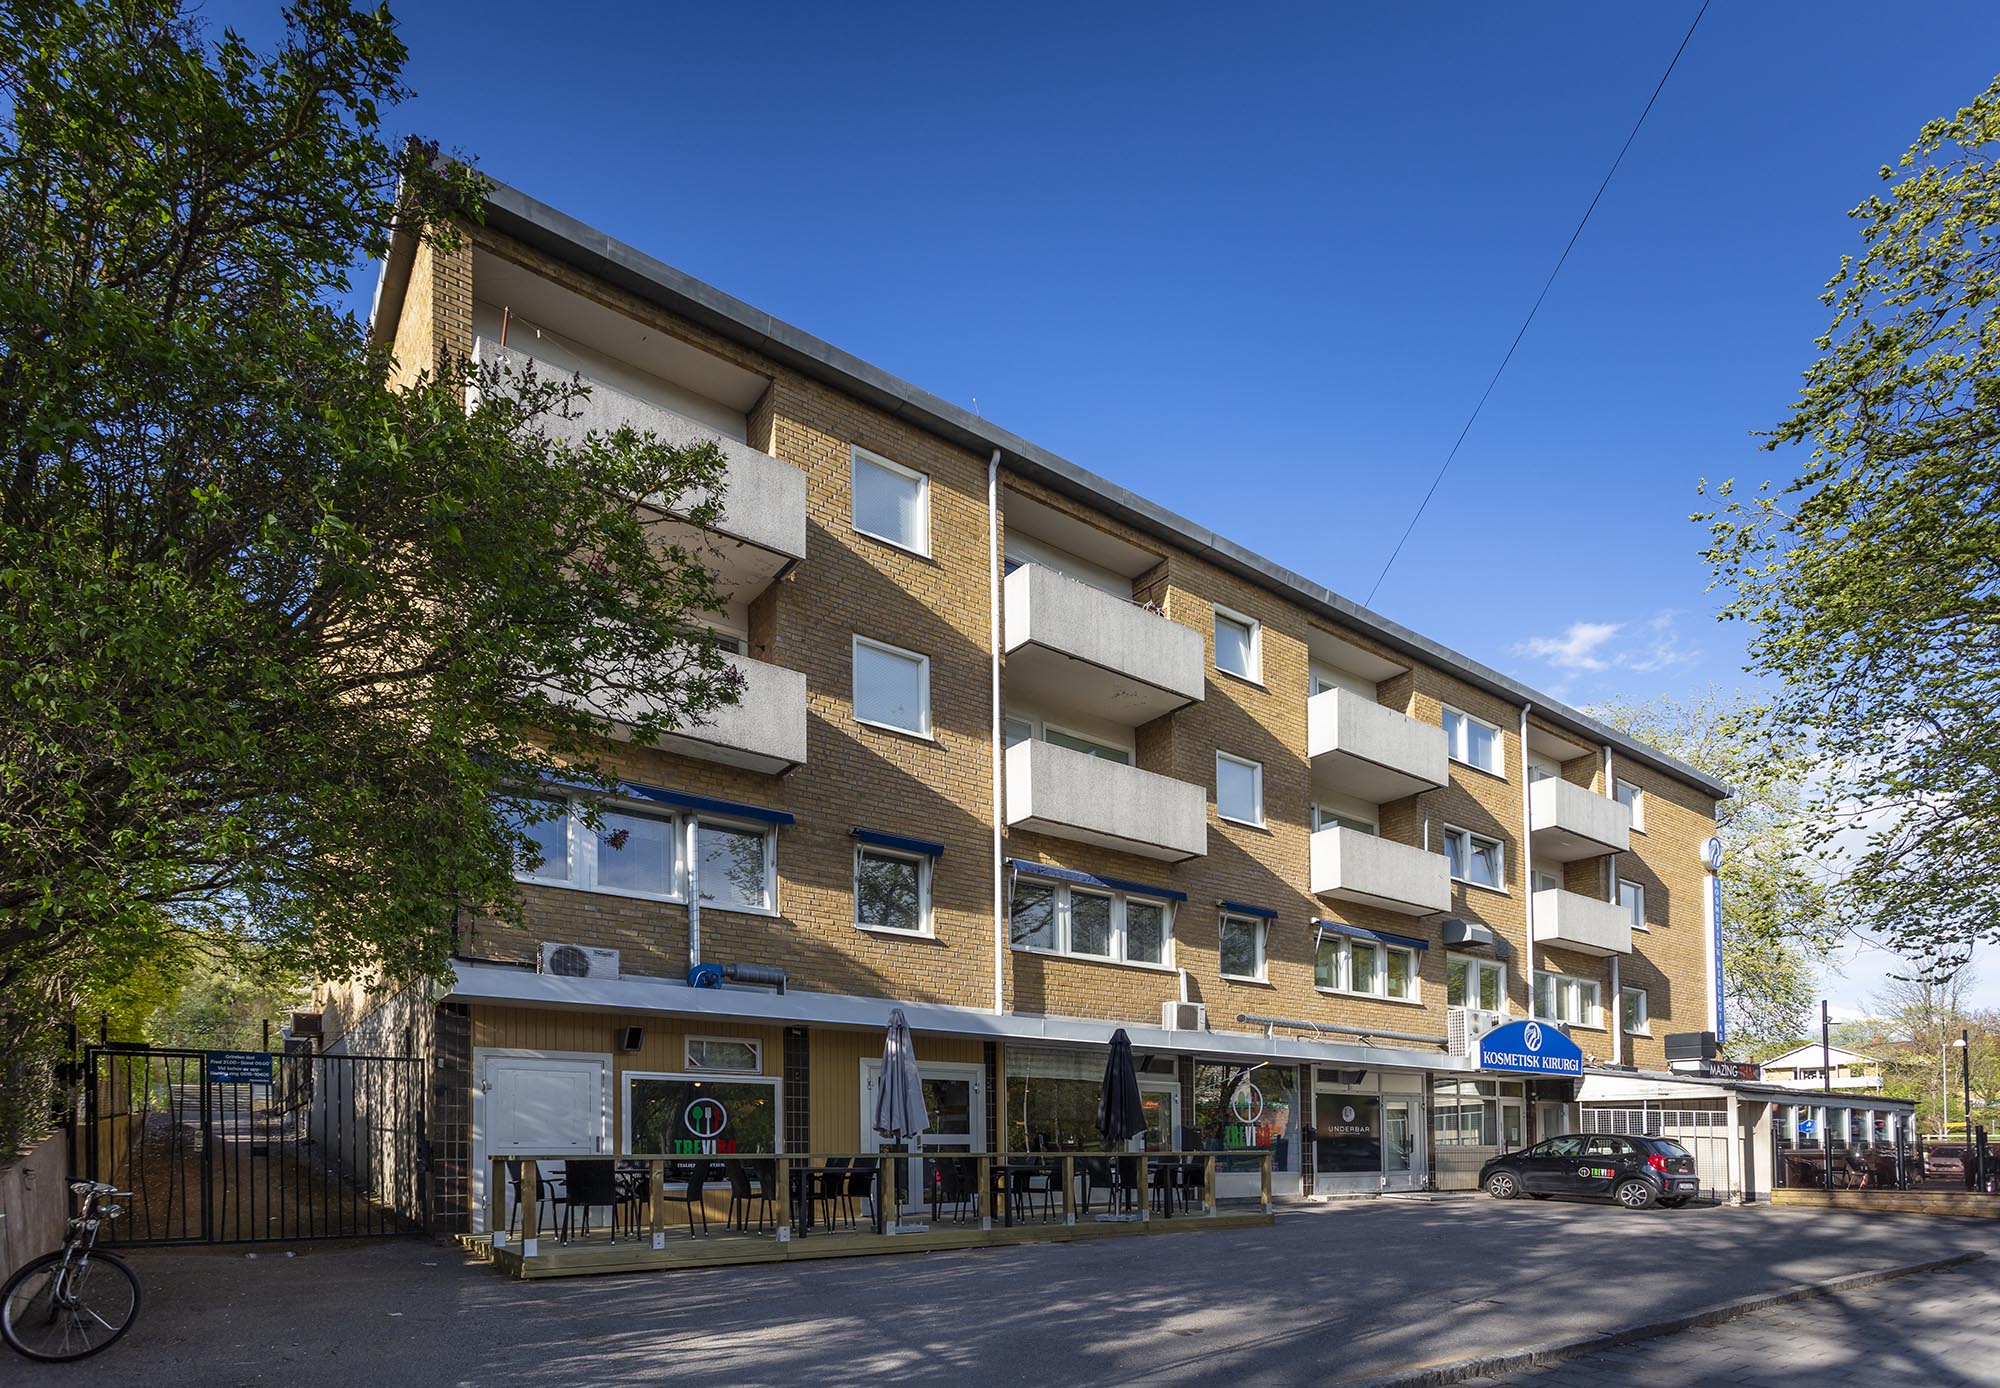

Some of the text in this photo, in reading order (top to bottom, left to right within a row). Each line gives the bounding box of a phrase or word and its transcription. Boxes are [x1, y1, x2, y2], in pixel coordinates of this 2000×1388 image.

[1483, 1051, 1579, 1071] KOSMETISK KIRURGI
[1710, 1063, 1738, 1077] MAZING
